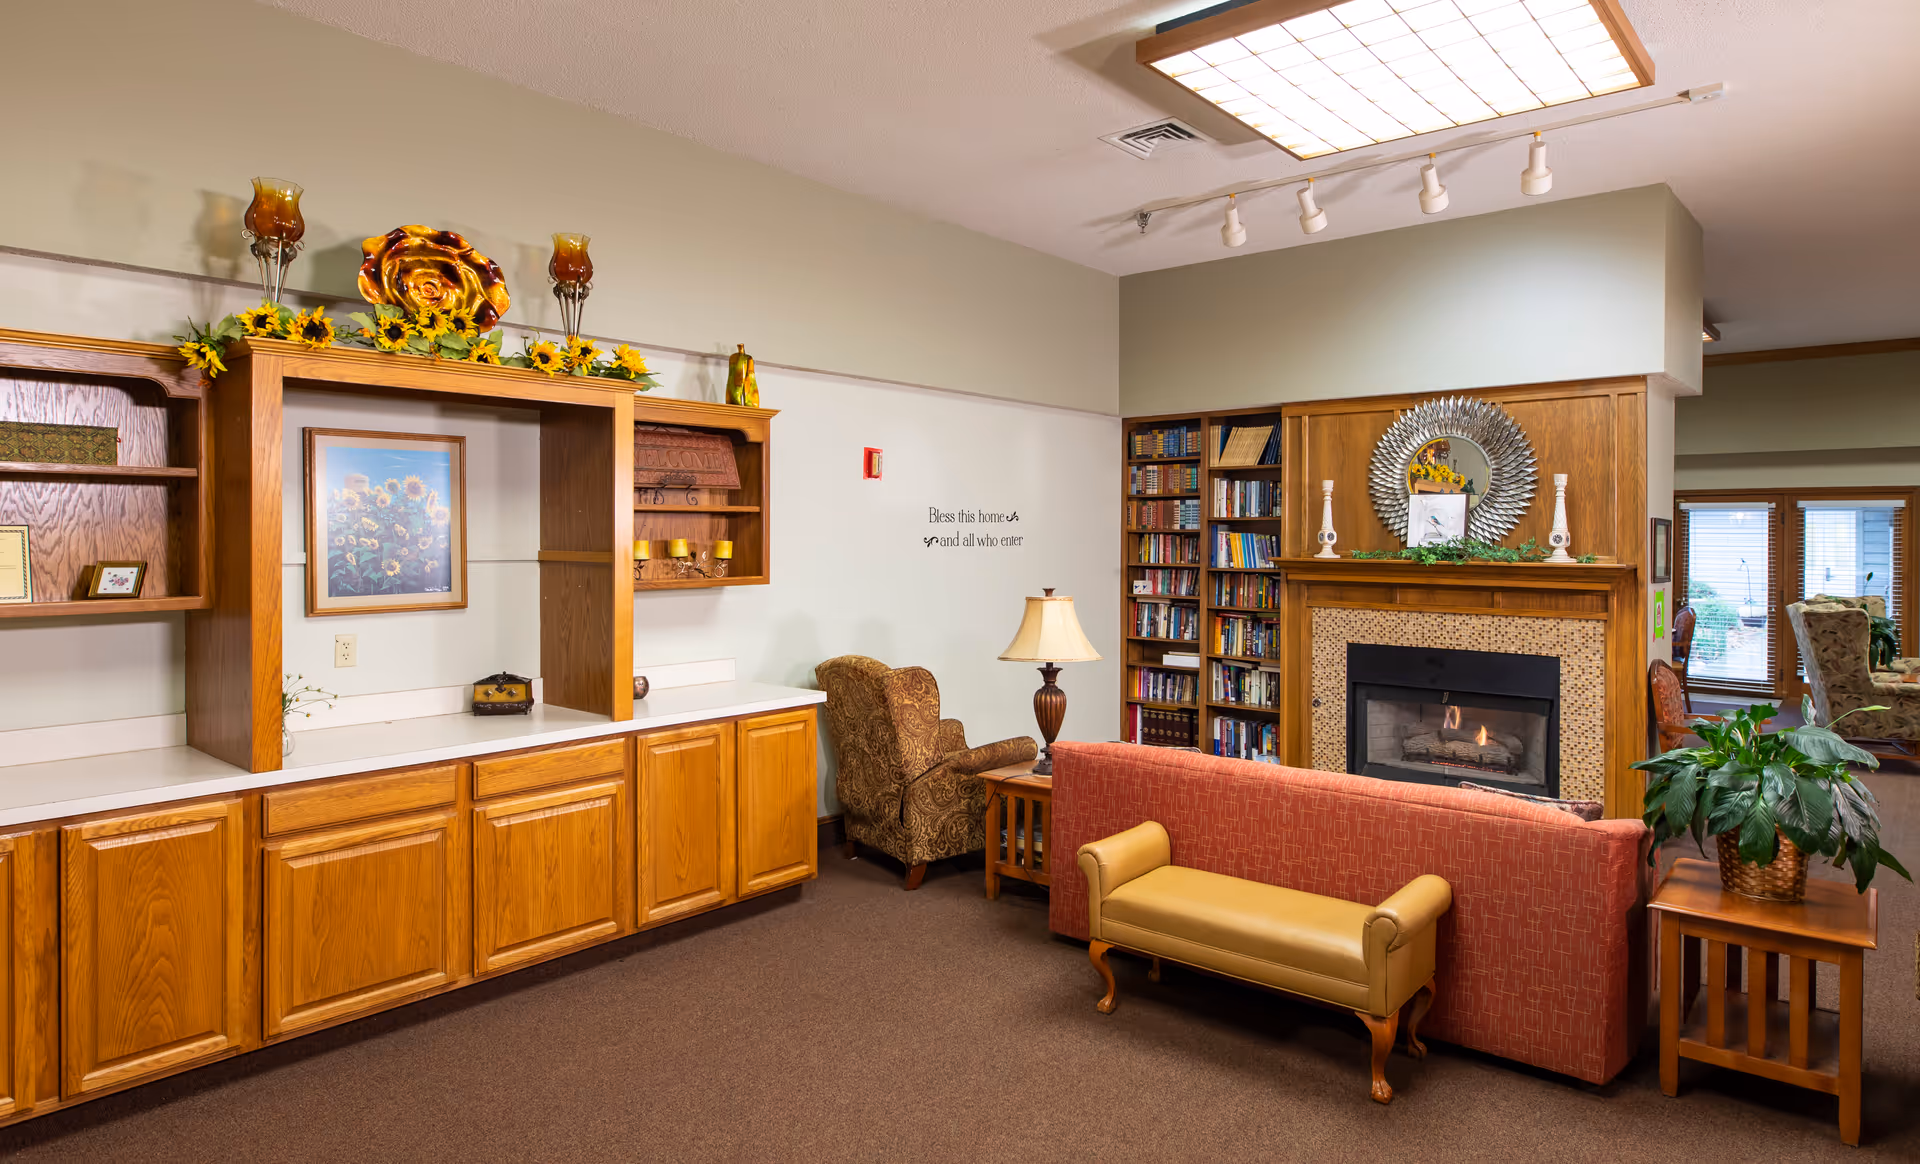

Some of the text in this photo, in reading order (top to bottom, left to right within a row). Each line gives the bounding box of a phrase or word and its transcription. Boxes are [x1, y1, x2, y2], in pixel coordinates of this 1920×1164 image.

[929, 506, 1005, 523] Bless this home
[939, 530, 1024, 547] and all who enter
